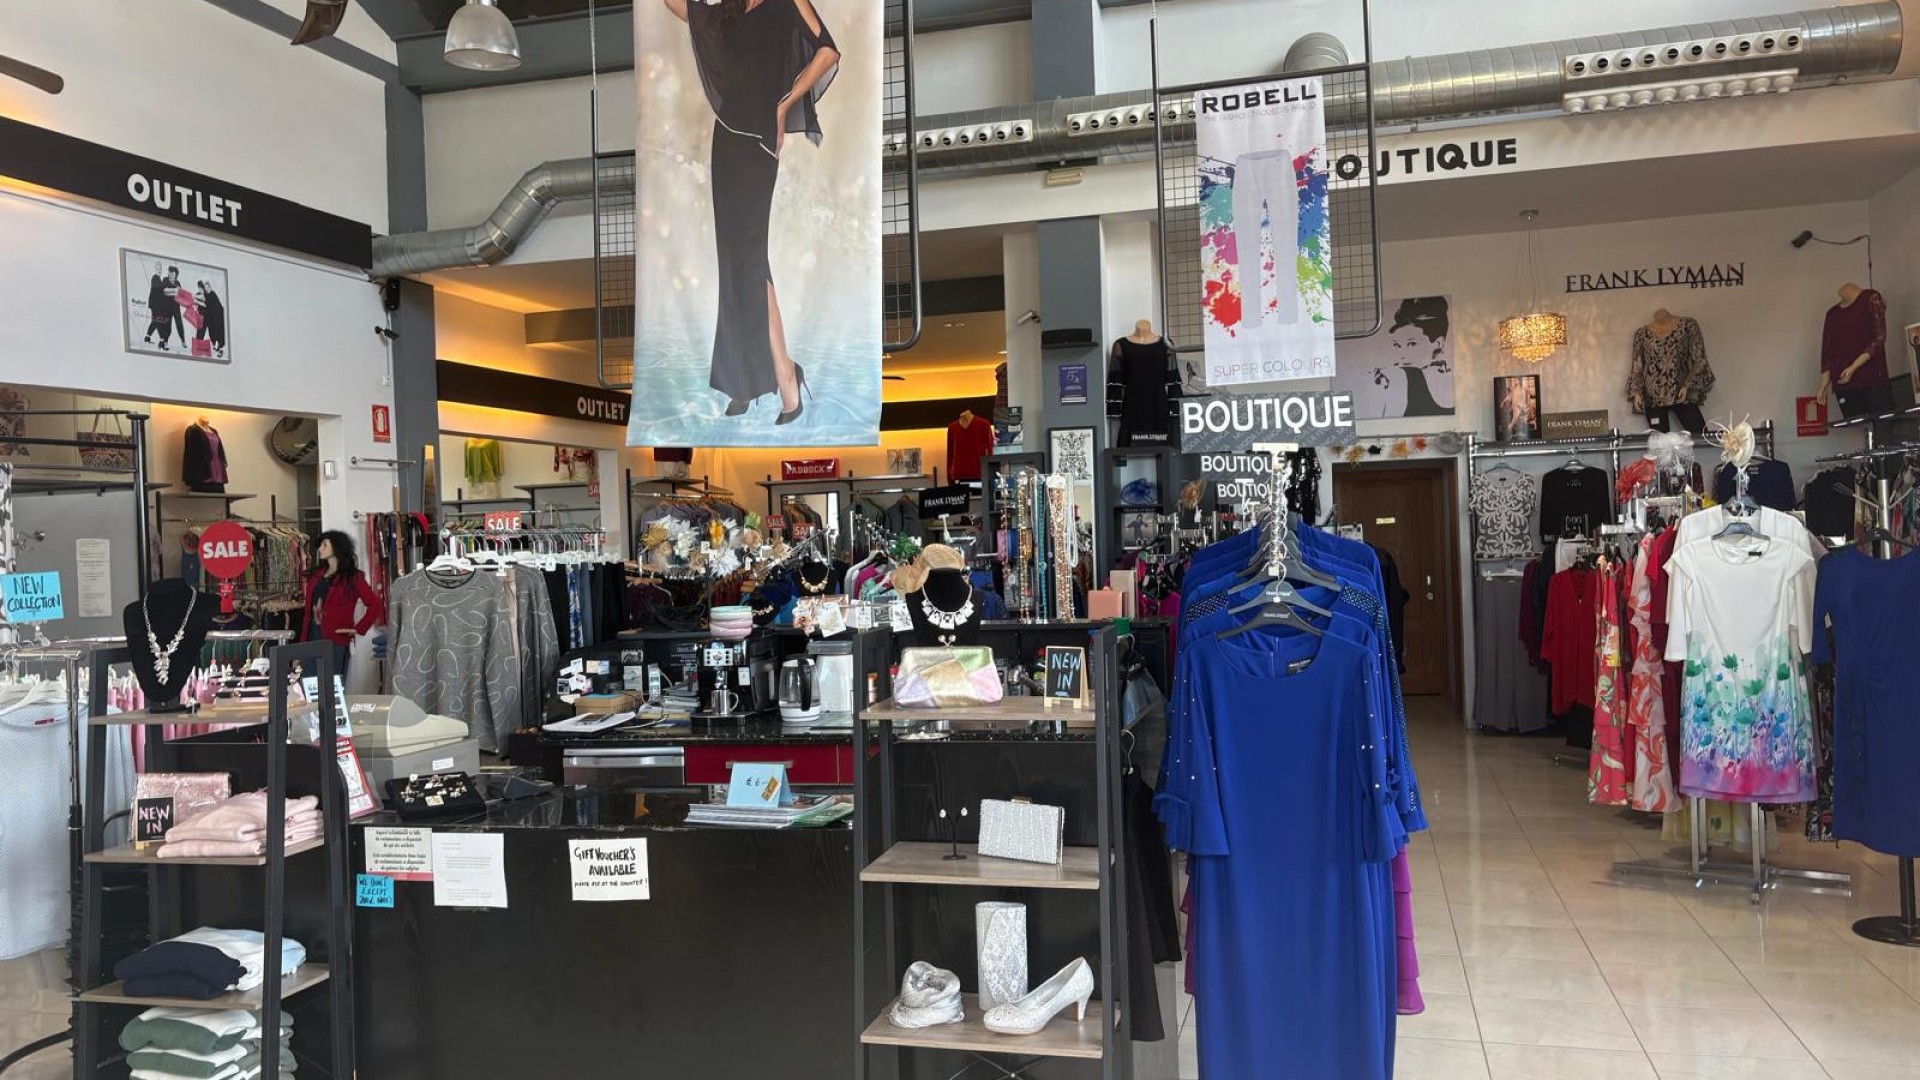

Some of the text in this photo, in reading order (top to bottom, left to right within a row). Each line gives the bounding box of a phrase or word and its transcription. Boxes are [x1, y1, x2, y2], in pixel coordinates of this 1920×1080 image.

[1202, 84, 1316, 113] ROBELL
[1326, 138, 1517, 180] OUTIQUE
[127, 173, 242, 227] OUTLET
[1565, 262, 1745, 293] FRANK LYMAN
[1691, 279, 1744, 289] DESIGN
[1214, 356, 1331, 377] SUPER COLOURS
[577, 396, 625, 420] OUTLET
[1183, 395, 1352, 433] BOUTIQUE
[1547, 420, 1573, 428] FRANK
[487, 516, 520, 531] SALE
[203, 541, 248, 559] SALE
[13, 575, 44, 595] NEW
[7, 594, 60, 612] COLLECTION
[1052, 652, 1081, 670] NEW
[1057, 671, 1073, 690] IN
[139, 805, 169, 820] NEW
[146, 820, 162, 834] IN
[574, 847, 636, 861] GIFT VOUCHER'S
[589, 863, 636, 876] AVAILABLE
